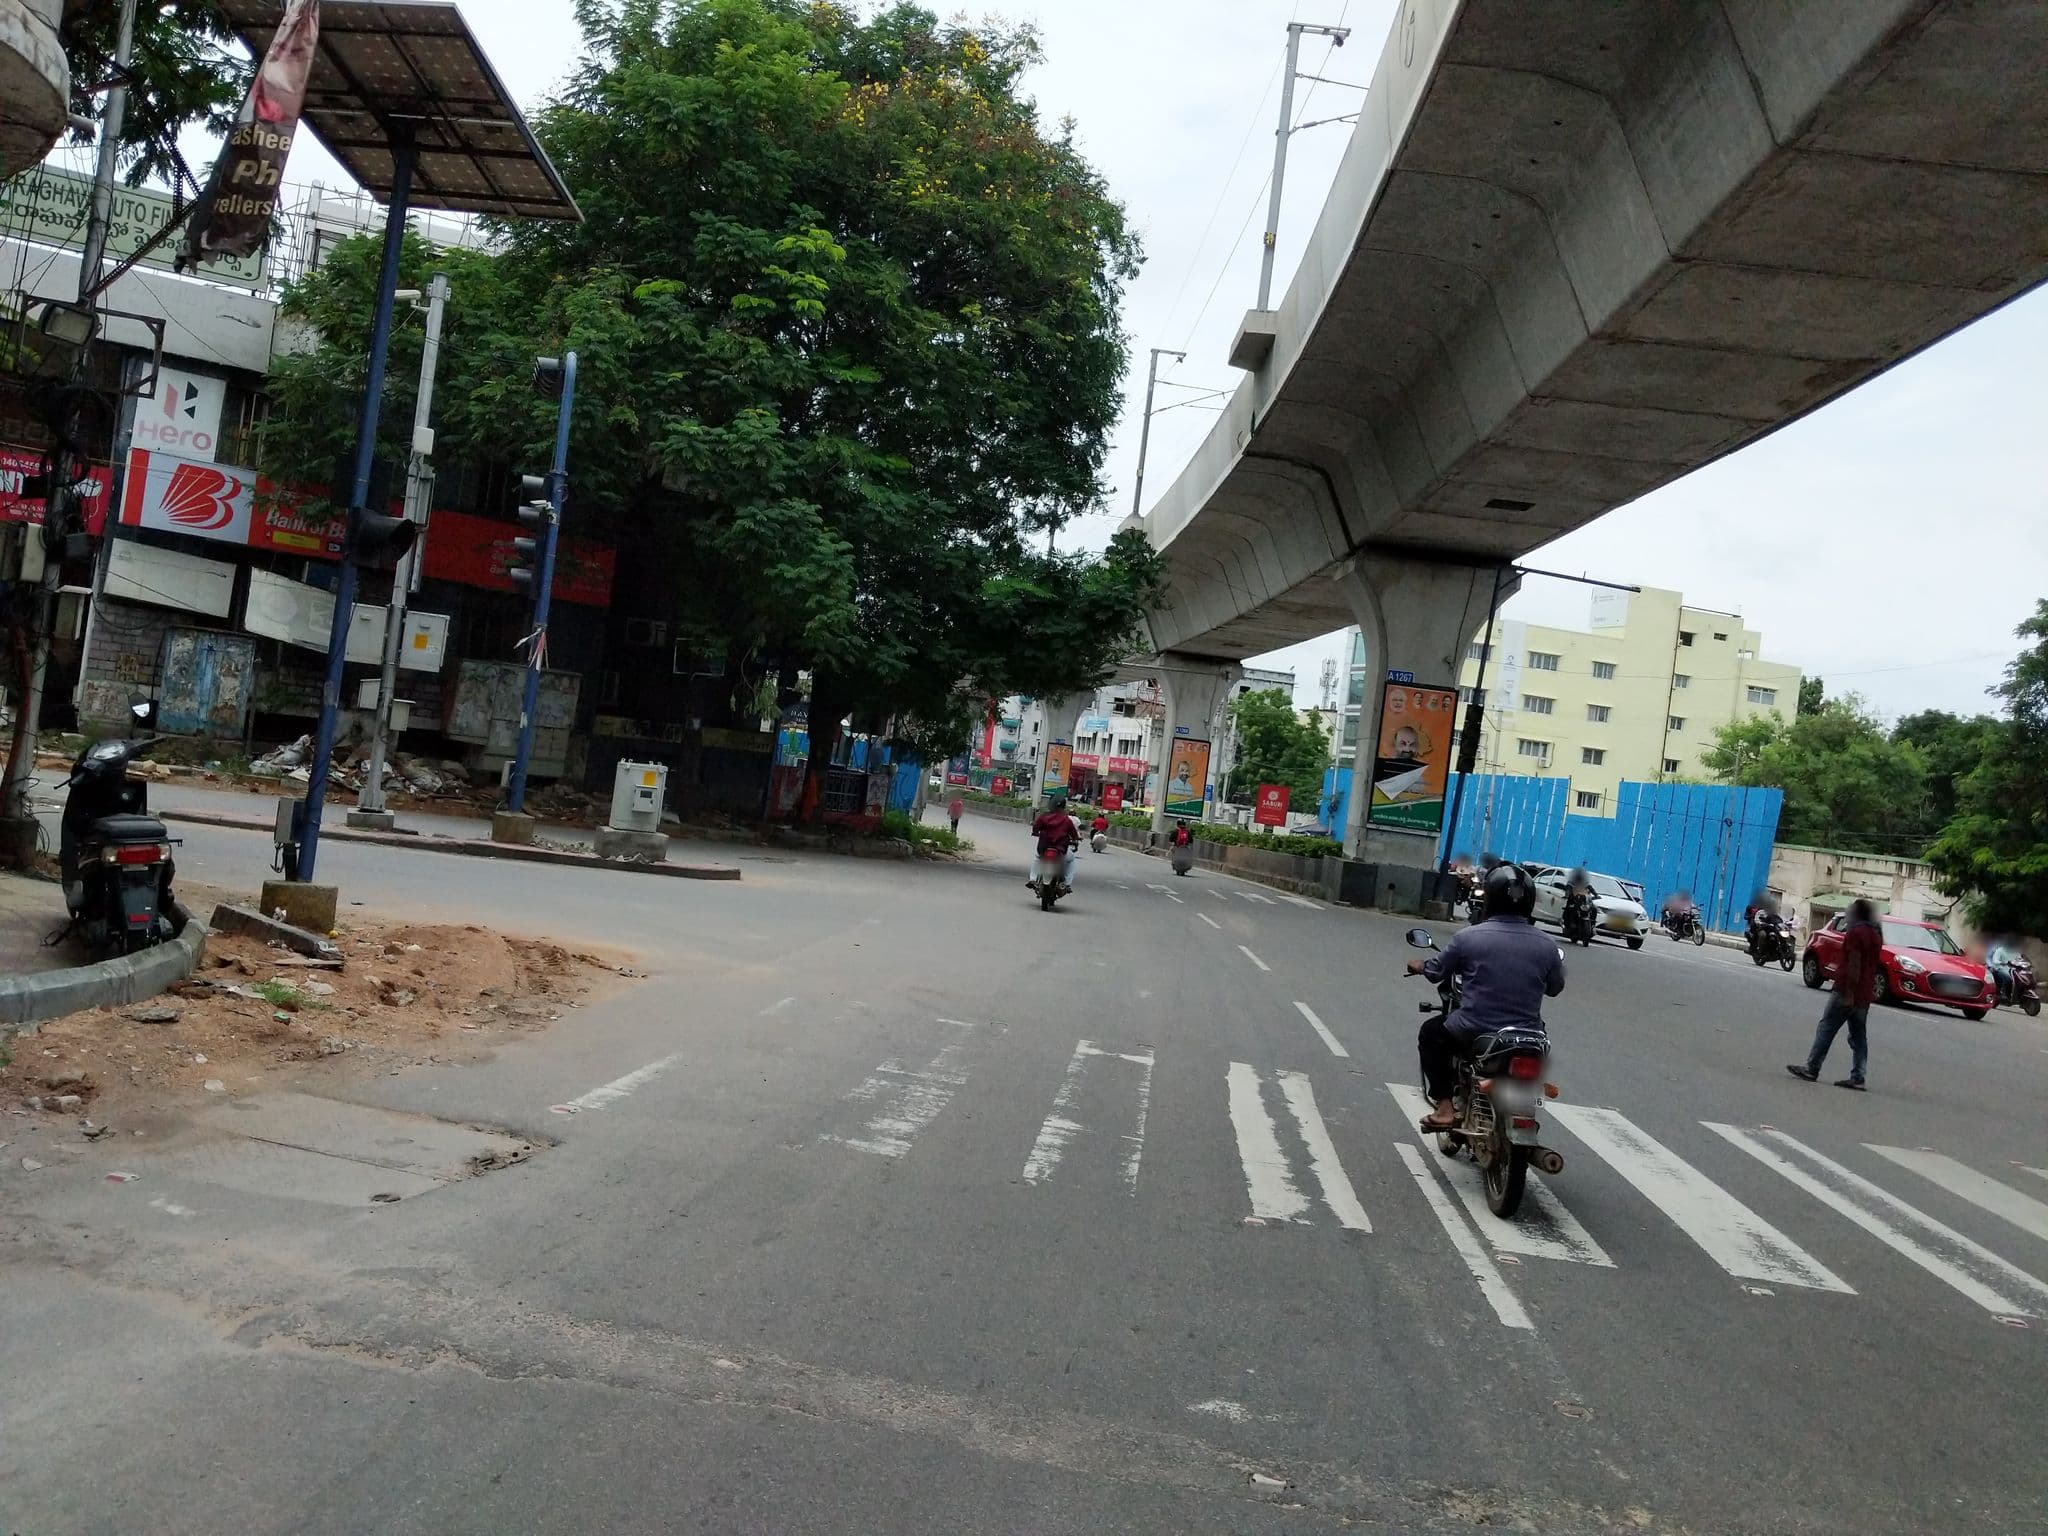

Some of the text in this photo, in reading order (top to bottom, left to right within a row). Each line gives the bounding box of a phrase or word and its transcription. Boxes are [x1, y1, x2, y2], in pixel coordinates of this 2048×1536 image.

[14, 175, 88, 209] RAGHAV
[112, 197, 147, 223] UTO
[137, 420, 212, 452] Hero
